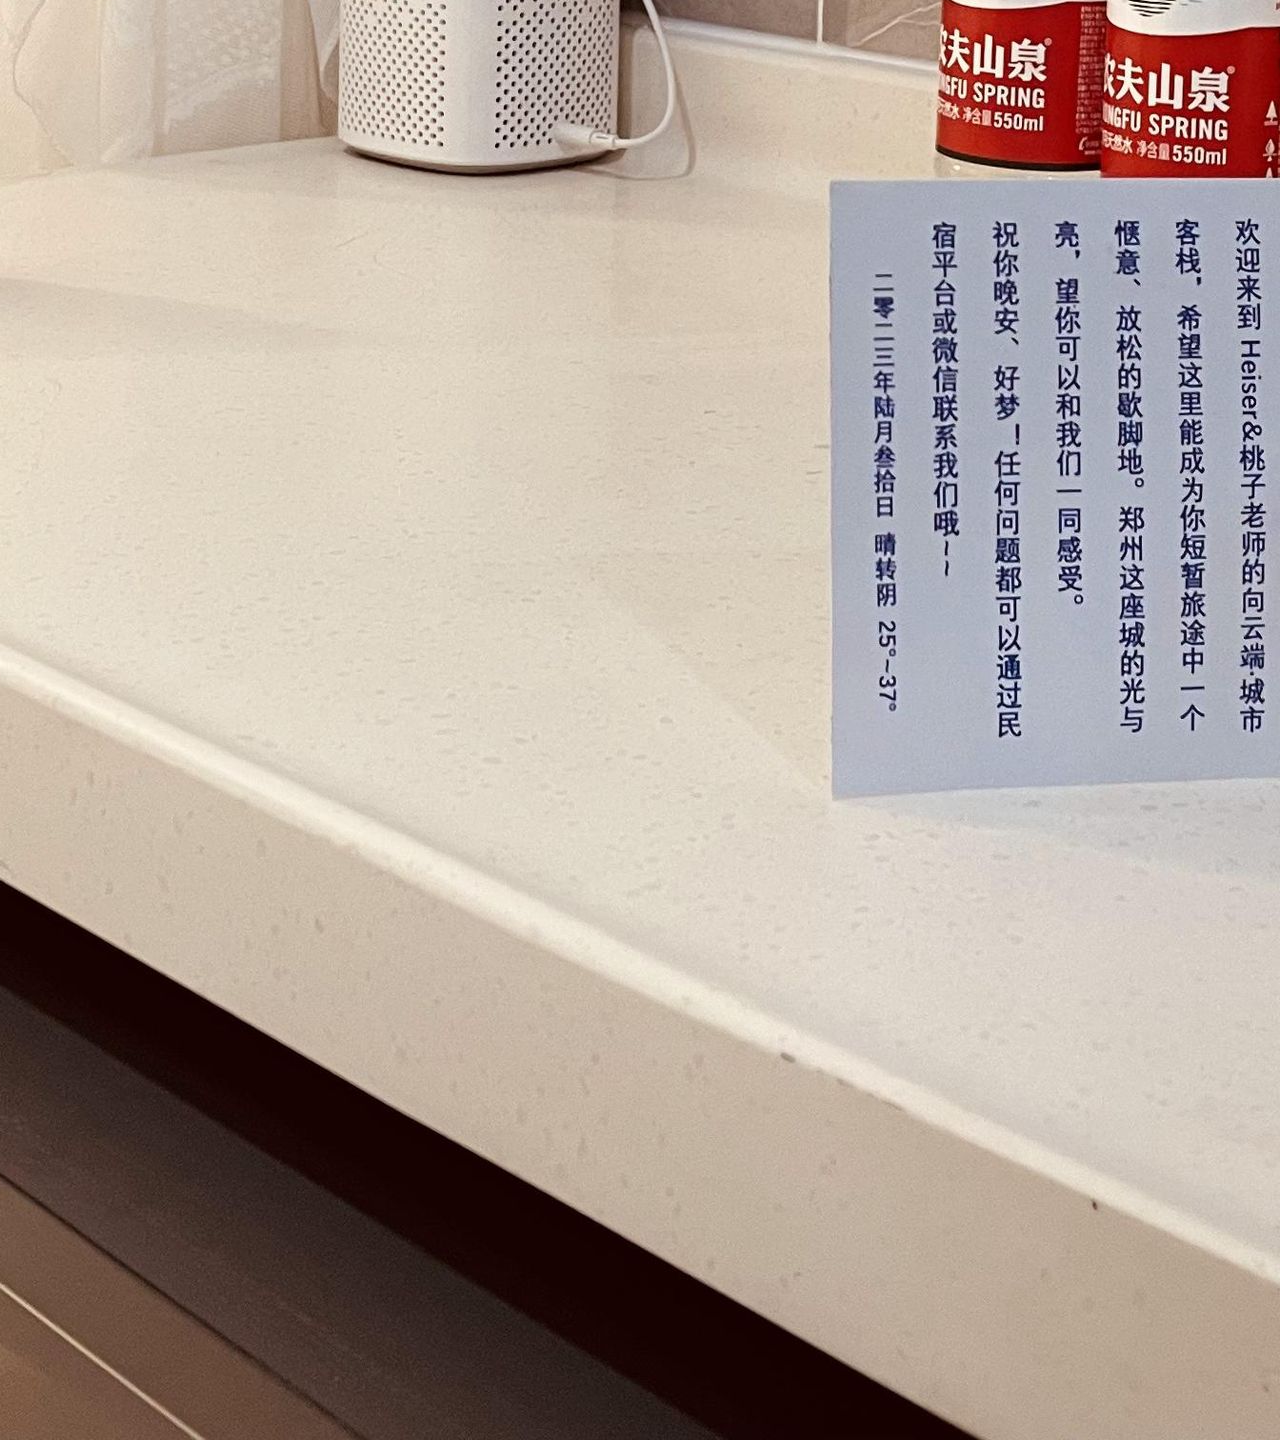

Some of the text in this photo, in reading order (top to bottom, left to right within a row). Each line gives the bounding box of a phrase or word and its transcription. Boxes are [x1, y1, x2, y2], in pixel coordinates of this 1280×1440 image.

[972, 81, 1046, 109] SPRING
[1148, 113, 1229, 142] SPRING
[872, 273, 897, 519] 二零二三年陆月叁拾日
[874, 531, 898, 608] 晴转阴
